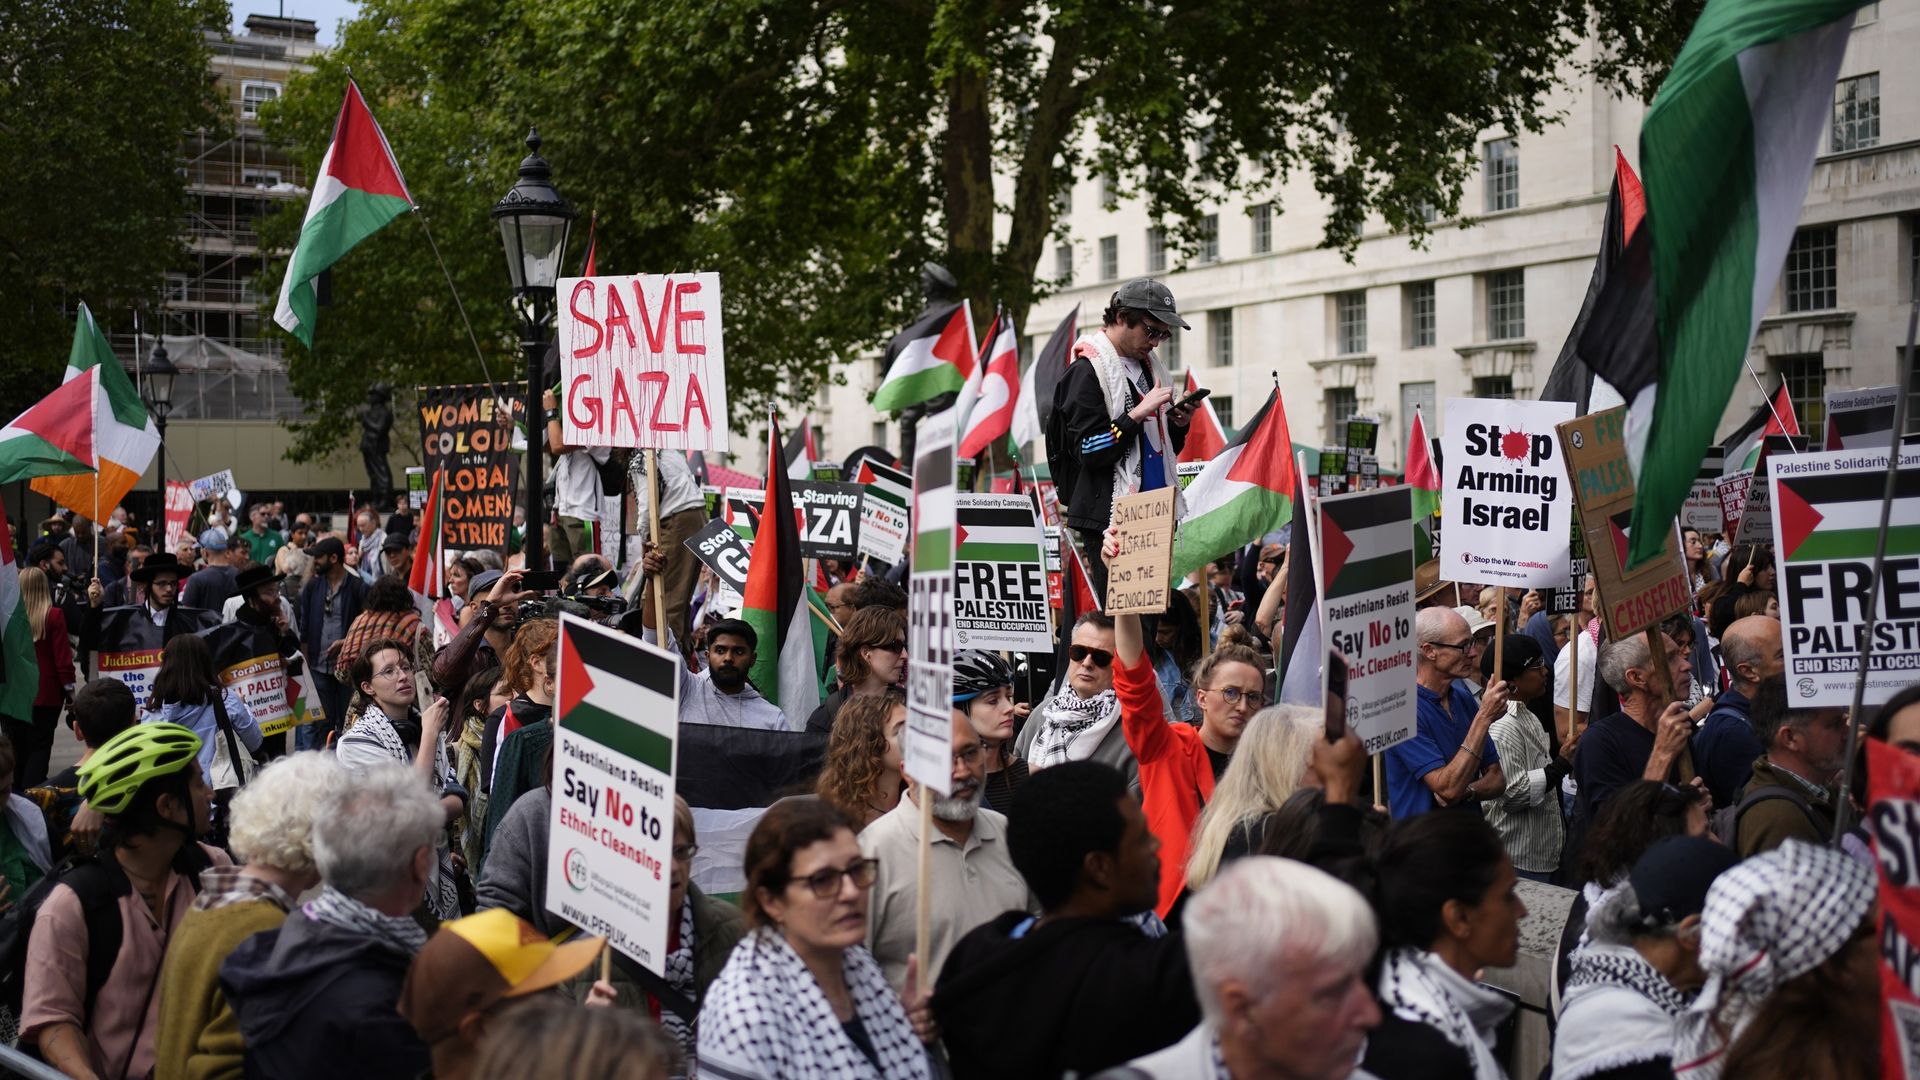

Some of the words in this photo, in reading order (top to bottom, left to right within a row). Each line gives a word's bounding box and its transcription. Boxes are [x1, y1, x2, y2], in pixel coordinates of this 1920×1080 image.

[569, 279, 706, 359] SAVE
[567, 367, 712, 438] GAZA
[1829, 399, 1853, 410] Palestine
[425, 428, 511, 456] COLOU
[462, 455, 470, 464] in
[474, 455, 487, 464] the
[1776, 459, 1831, 475] Palestine
[1834, 456, 1889, 470] Solidarity
[1457, 466, 1557, 502] Arming
[1701, 489, 1711, 498] No
[1720, 483, 1732, 495] IT'S
[1733, 480, 1746, 491] NOT
[442, 490, 512, 519] OMEN'S
[803, 488, 858, 509] Starving
[957, 499, 971, 507] stine
[972, 499, 1001, 508] Solidarity
[1750, 489, 1766, 504] Say
[875, 510, 890, 524] No
[893, 517, 904, 529] to
[1115, 500, 1169, 526] SANCTION
[1462, 497, 1550, 531] Israel
[444, 522, 505, 546] STRIKE
[699, 528, 735, 556] Stop
[1120, 530, 1158, 556] ISRAEL
[1110, 564, 1132, 583] END
[1137, 565, 1154, 581] THE
[1473, 555, 1490, 564] Stop
[1491, 557, 1502, 565] the
[1503, 558, 1517, 566] War
[1517, 560, 1549, 570] coalition
[954, 562, 1044, 602] FREE
[1480, 569, 1528, 579] www.stopwar.org.uk
[1107, 586, 1163, 610] GENOCIDE
[1329, 598, 1384, 622] Palestinians
[1386, 589, 1409, 608] Resist
[1554, 593, 1576, 611] FREE
[1615, 573, 1689, 635] CEASEFIRE
[954, 600, 1046, 620] PALESTINE
[957, 621, 971, 629] END
[972, 621, 1000, 631] ISRAELI
[1001, 622, 1046, 632] OCCUPATION
[1331, 629, 1364, 659] Say
[1368, 620, 1392, 649] No
[1394, 616, 1410, 640] to
[102, 653, 154, 667] Judaism
[231, 663, 261, 678] Torah
[1367, 649, 1412, 676] Cleansing
[1794, 659, 1823, 673] END
[1827, 657, 1882, 672] ISRALI
[122, 671, 145, 682] the
[253, 692, 280, 706] returned
[562, 739, 627, 782] Palestinians
[629, 770, 664, 800] Resist
[564, 767, 599, 818] Say
[605, 786, 634, 828] No
[640, 805, 661, 841] to
[559, 807, 598, 842] Ethnic
[601, 827, 663, 881] Cleansing
[561, 900, 651, 963] www.PFBUK.com
